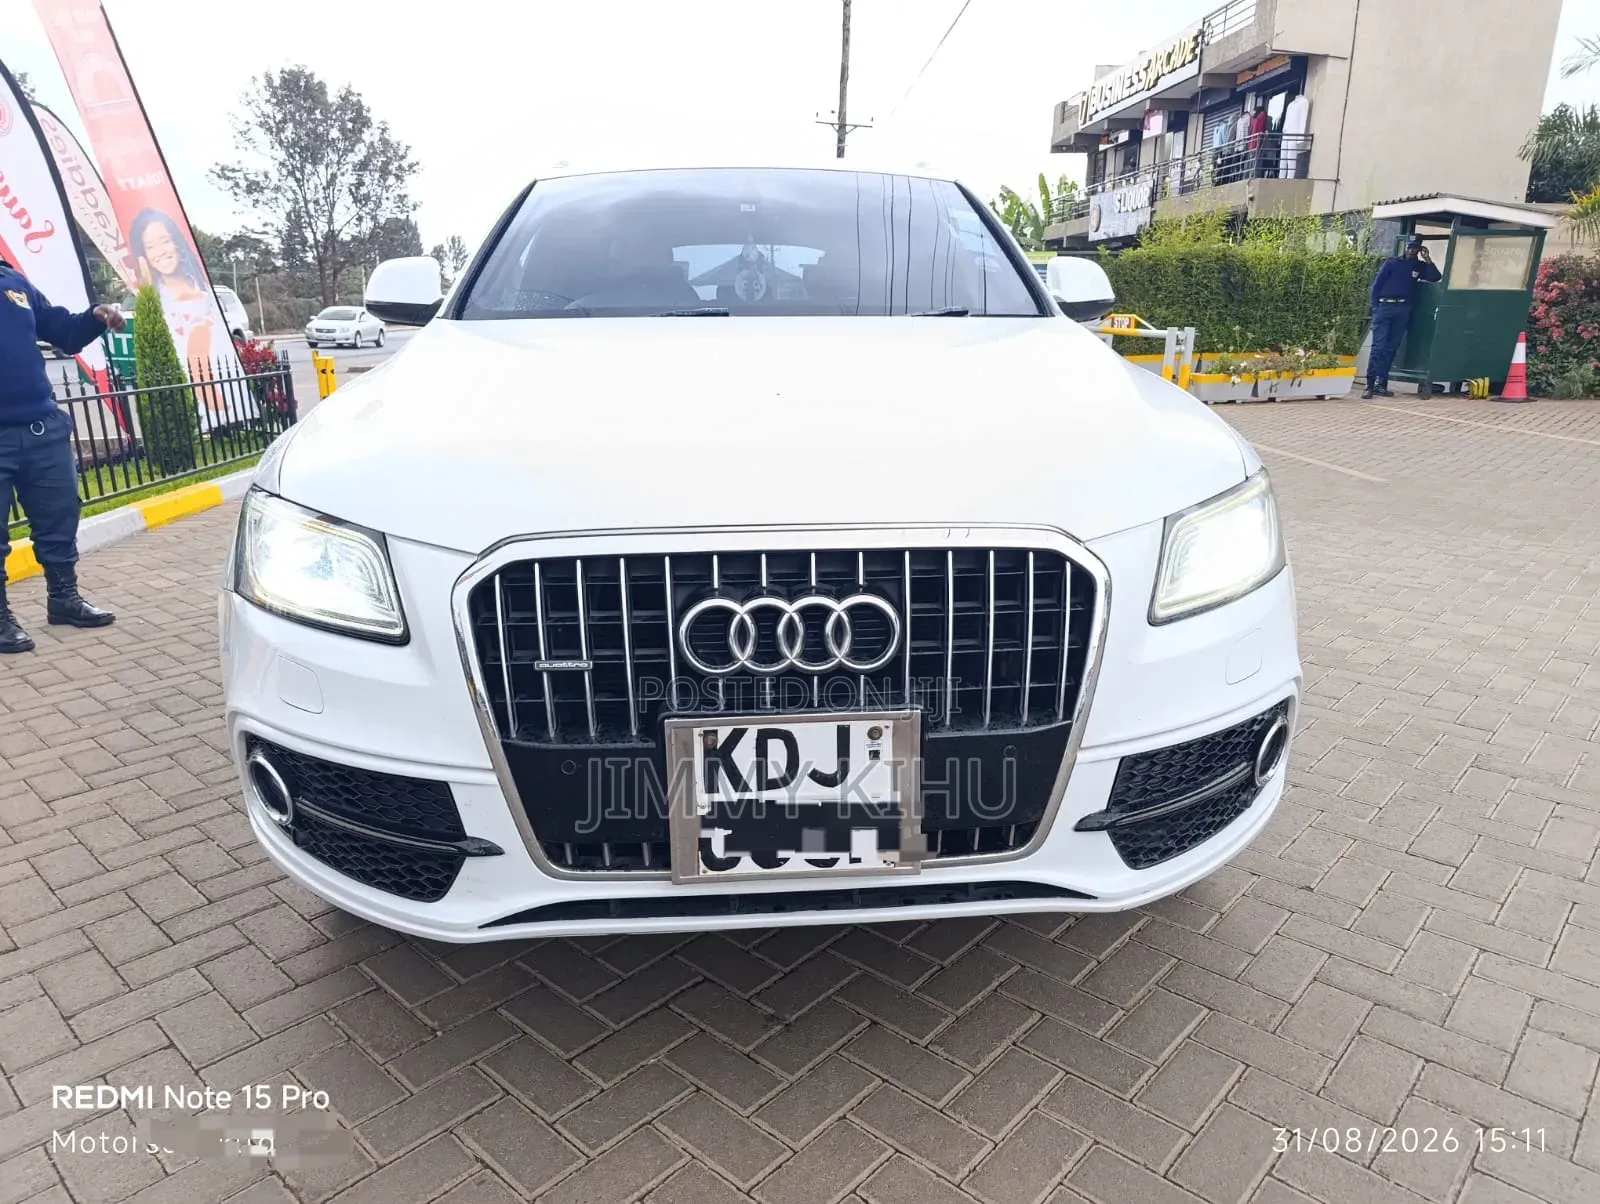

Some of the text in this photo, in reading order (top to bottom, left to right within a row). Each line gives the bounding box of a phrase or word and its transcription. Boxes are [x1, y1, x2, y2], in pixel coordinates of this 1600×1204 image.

[1088, 59, 1151, 119] BUSINESS
[1144, 30, 1201, 92] ARCADE
[702, 724, 851, 794] KDJ
